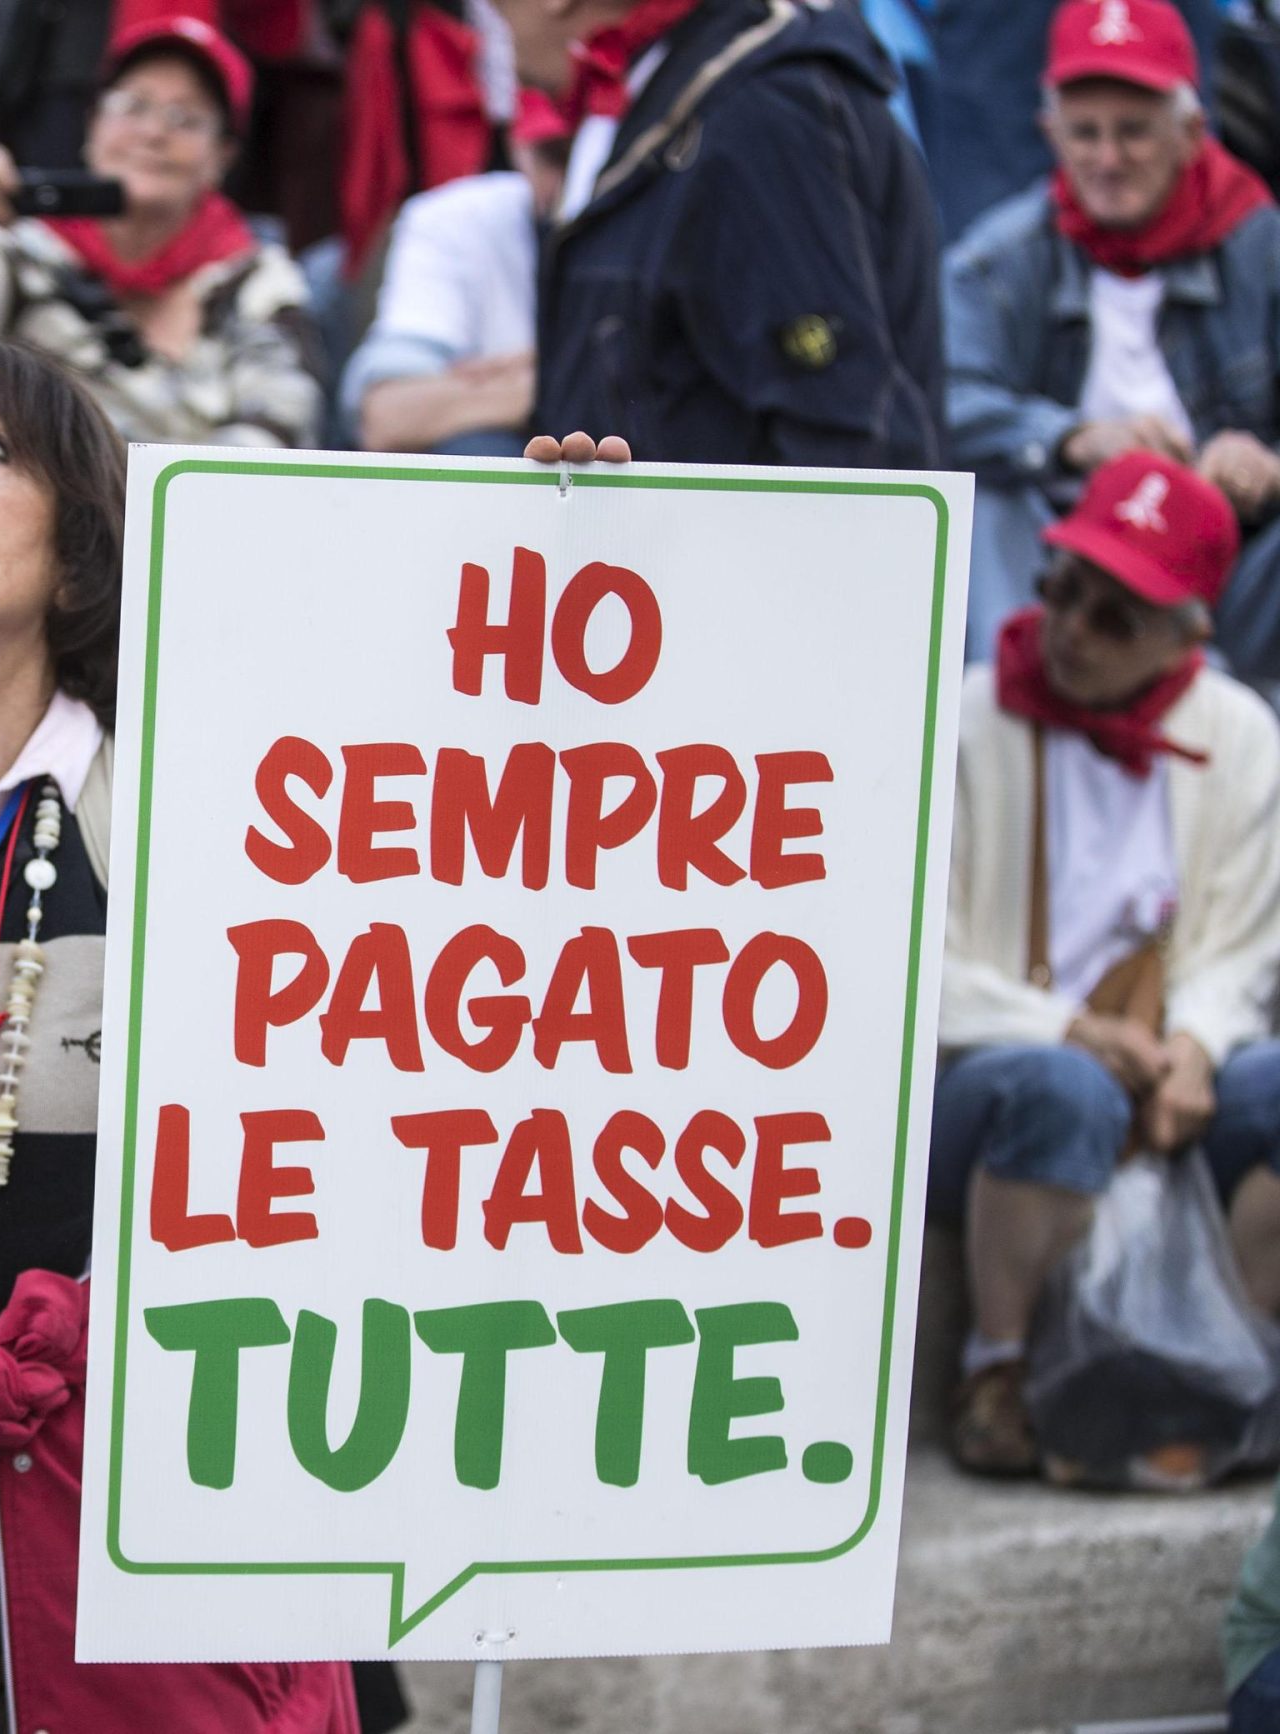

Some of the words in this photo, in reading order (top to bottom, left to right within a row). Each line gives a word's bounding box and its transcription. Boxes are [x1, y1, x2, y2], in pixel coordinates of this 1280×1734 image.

[448, 547, 661, 704] HO
[245, 736, 833, 890] SEMPRE
[228, 919, 827, 1073] PAGATO
[150, 1104, 325, 1251] LE
[392, 1109, 871, 1253] TASSE.
[144, 1298, 852, 1492] TUTTE.
